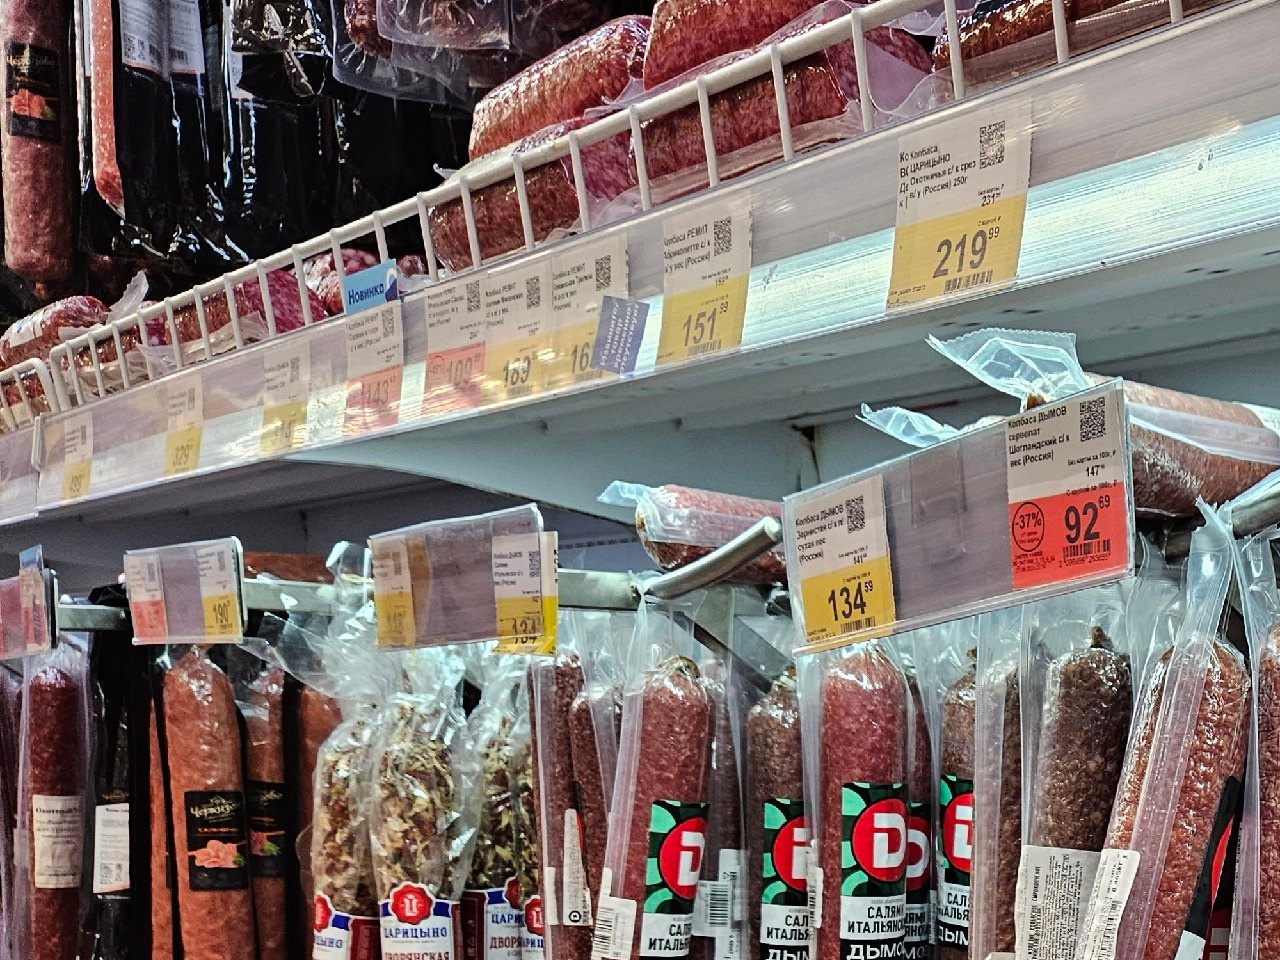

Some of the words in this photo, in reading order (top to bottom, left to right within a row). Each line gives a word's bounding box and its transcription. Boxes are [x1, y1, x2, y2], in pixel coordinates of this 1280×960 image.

[933, 229, 987, 278] 219
[988, 226, 1000, 240] 99
[349, 281, 384, 306] Новинка
[683, 307, 717, 346] 151
[1008, 416, 1037, 428] Колбаса
[1038, 406, 1067, 423] ДЫМОВ
[1023, 450, 1054, 467] (Россия)
[1086, 465, 1100, 477] 147
[820, 504, 844, 521] ДЫМОВ
[1015, 511, 1042, 530] -37%
[1065, 502, 1100, 543] 92
[1099, 495, 1110, 509] 69
[828, 582, 867, 621] 134
[865, 580, 874, 593] 59
